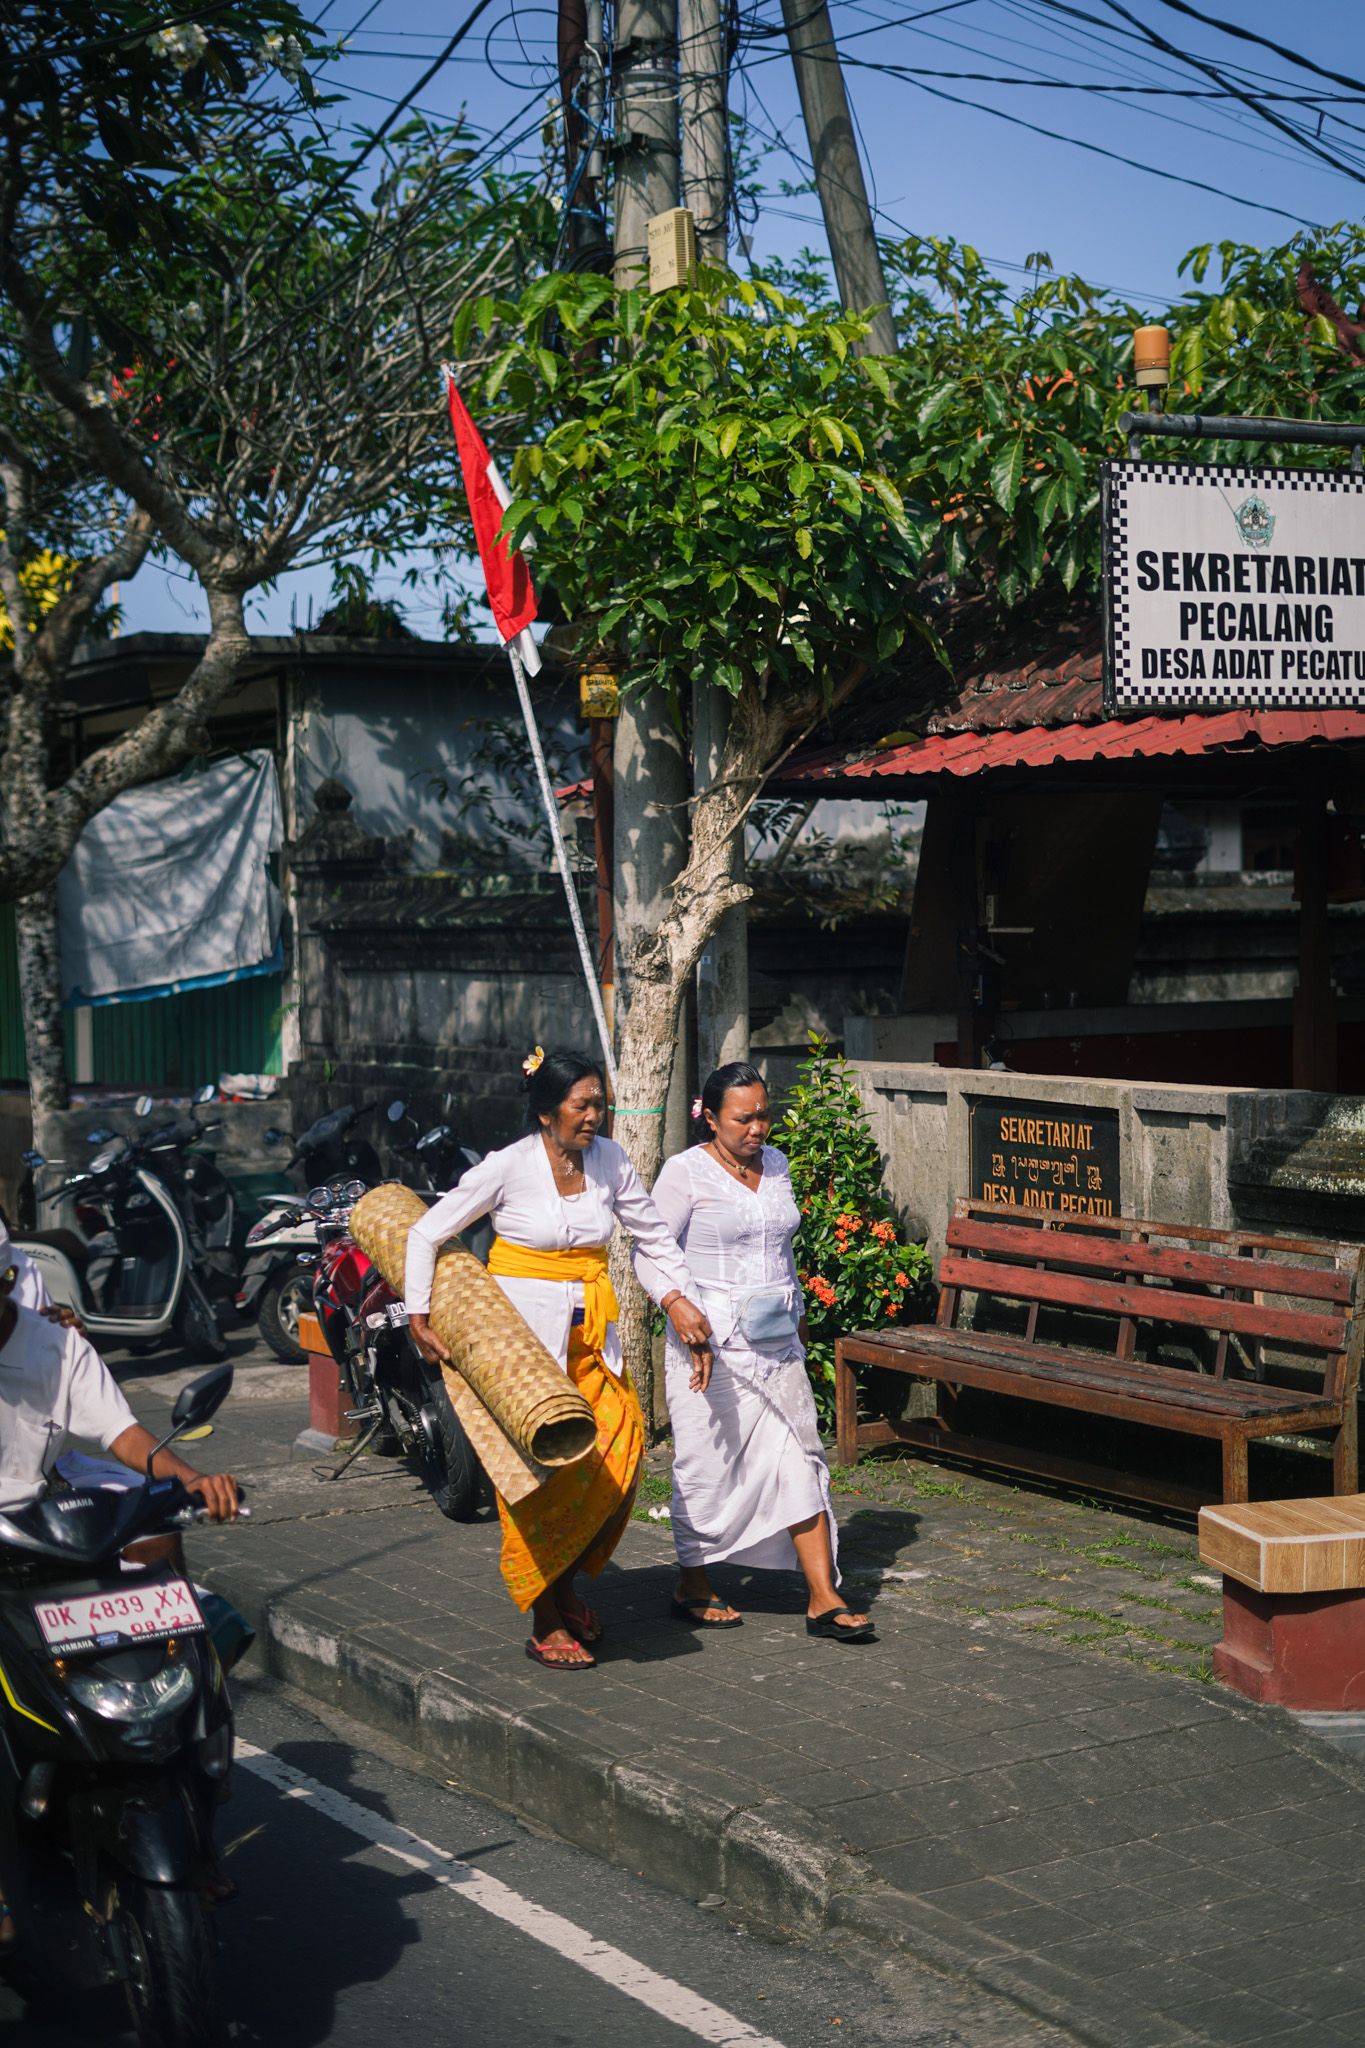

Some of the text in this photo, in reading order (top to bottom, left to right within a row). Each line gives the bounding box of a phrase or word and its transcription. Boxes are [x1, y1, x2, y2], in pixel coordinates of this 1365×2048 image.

[1136, 550, 1365, 596] SEKRETARIAT
[1180, 601, 1333, 643] PECALANG
[1141, 648, 1365, 681] DESA ADAT PECATU
[1000, 1116, 1093, 1151] SEKRETARIAT
[983, 1182, 1113, 1217] DESA ADAT PECATU
[57, 1497, 94, 1512] YAMAHA
[44, 1586, 188, 1628] DK 4839 XX
[60, 1639, 95, 1653] YAMAHA
